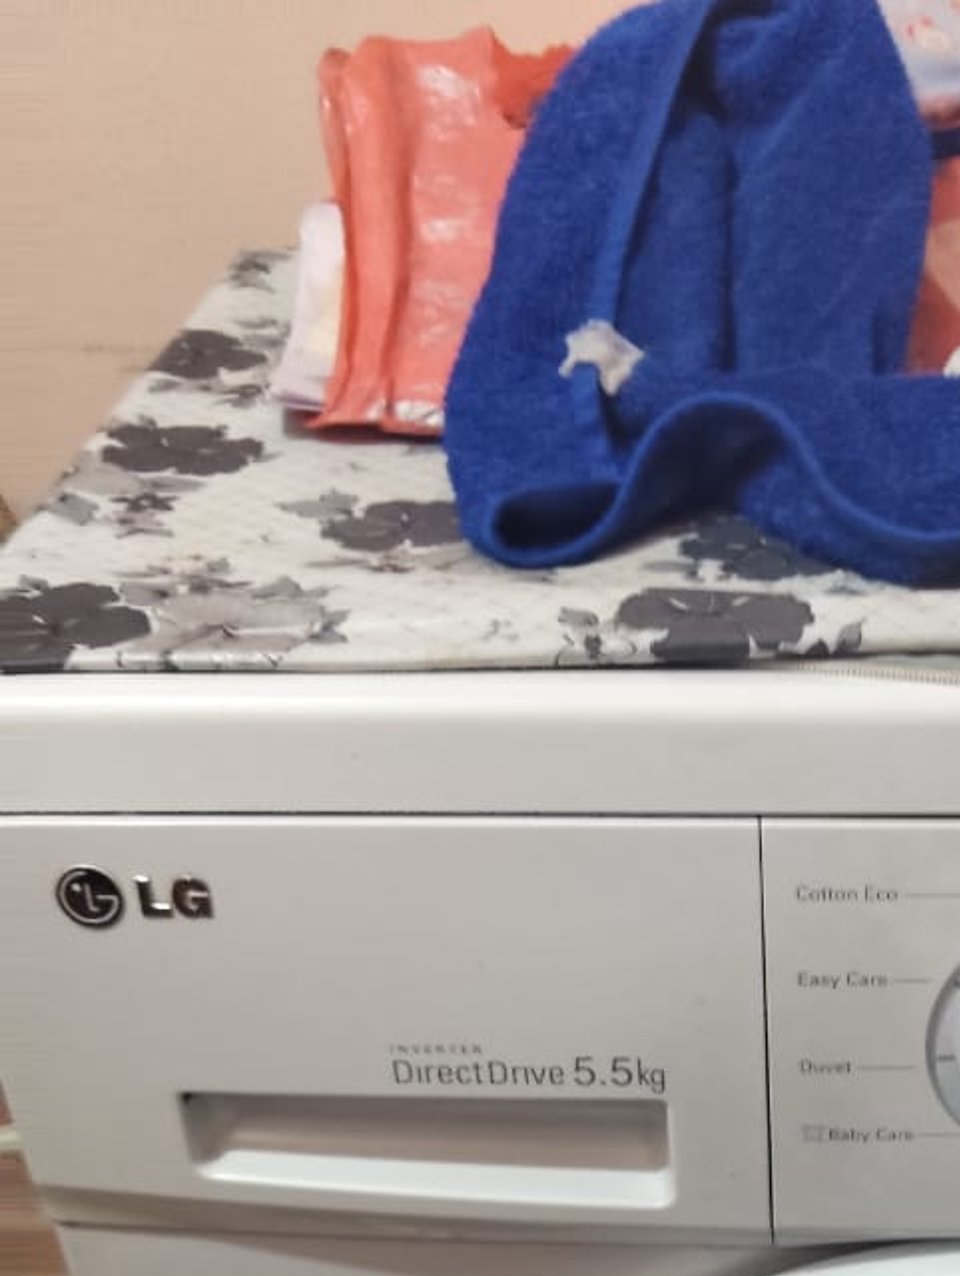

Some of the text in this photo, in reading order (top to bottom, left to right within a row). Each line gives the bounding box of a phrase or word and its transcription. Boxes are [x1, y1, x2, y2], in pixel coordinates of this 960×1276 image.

[133, 874, 215, 920] LG
[796, 883, 899, 902] Cotton Eco
[797, 971, 889, 990] Easy Care
[799, 1058, 852, 1075] Duvet
[828, 1125, 914, 1143] Baby Care
